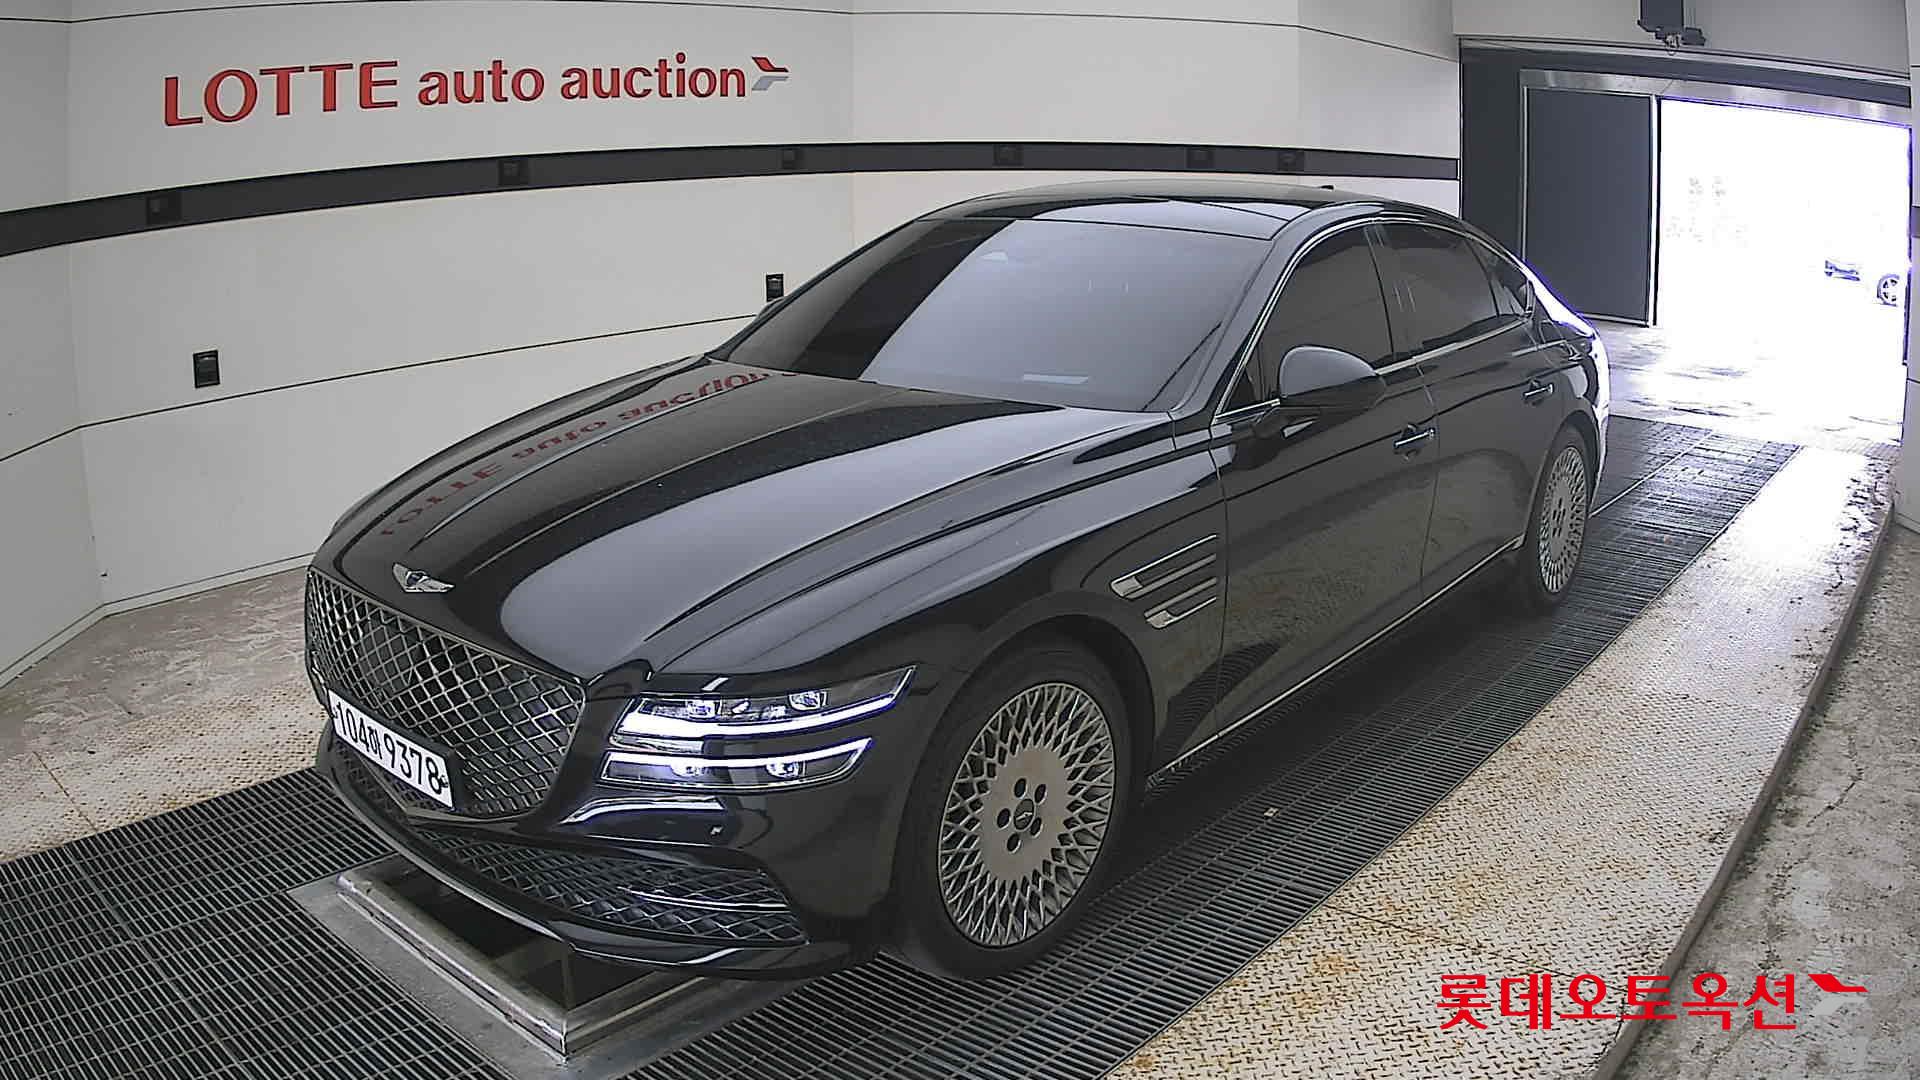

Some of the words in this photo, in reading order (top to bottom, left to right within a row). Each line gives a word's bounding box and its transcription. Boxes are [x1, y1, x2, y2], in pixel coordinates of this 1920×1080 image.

[164, 60, 399, 127] LOTTE
[418, 59, 545, 106] auto
[560, 52, 747, 99] auction
[383, 733, 442, 795] 9378
